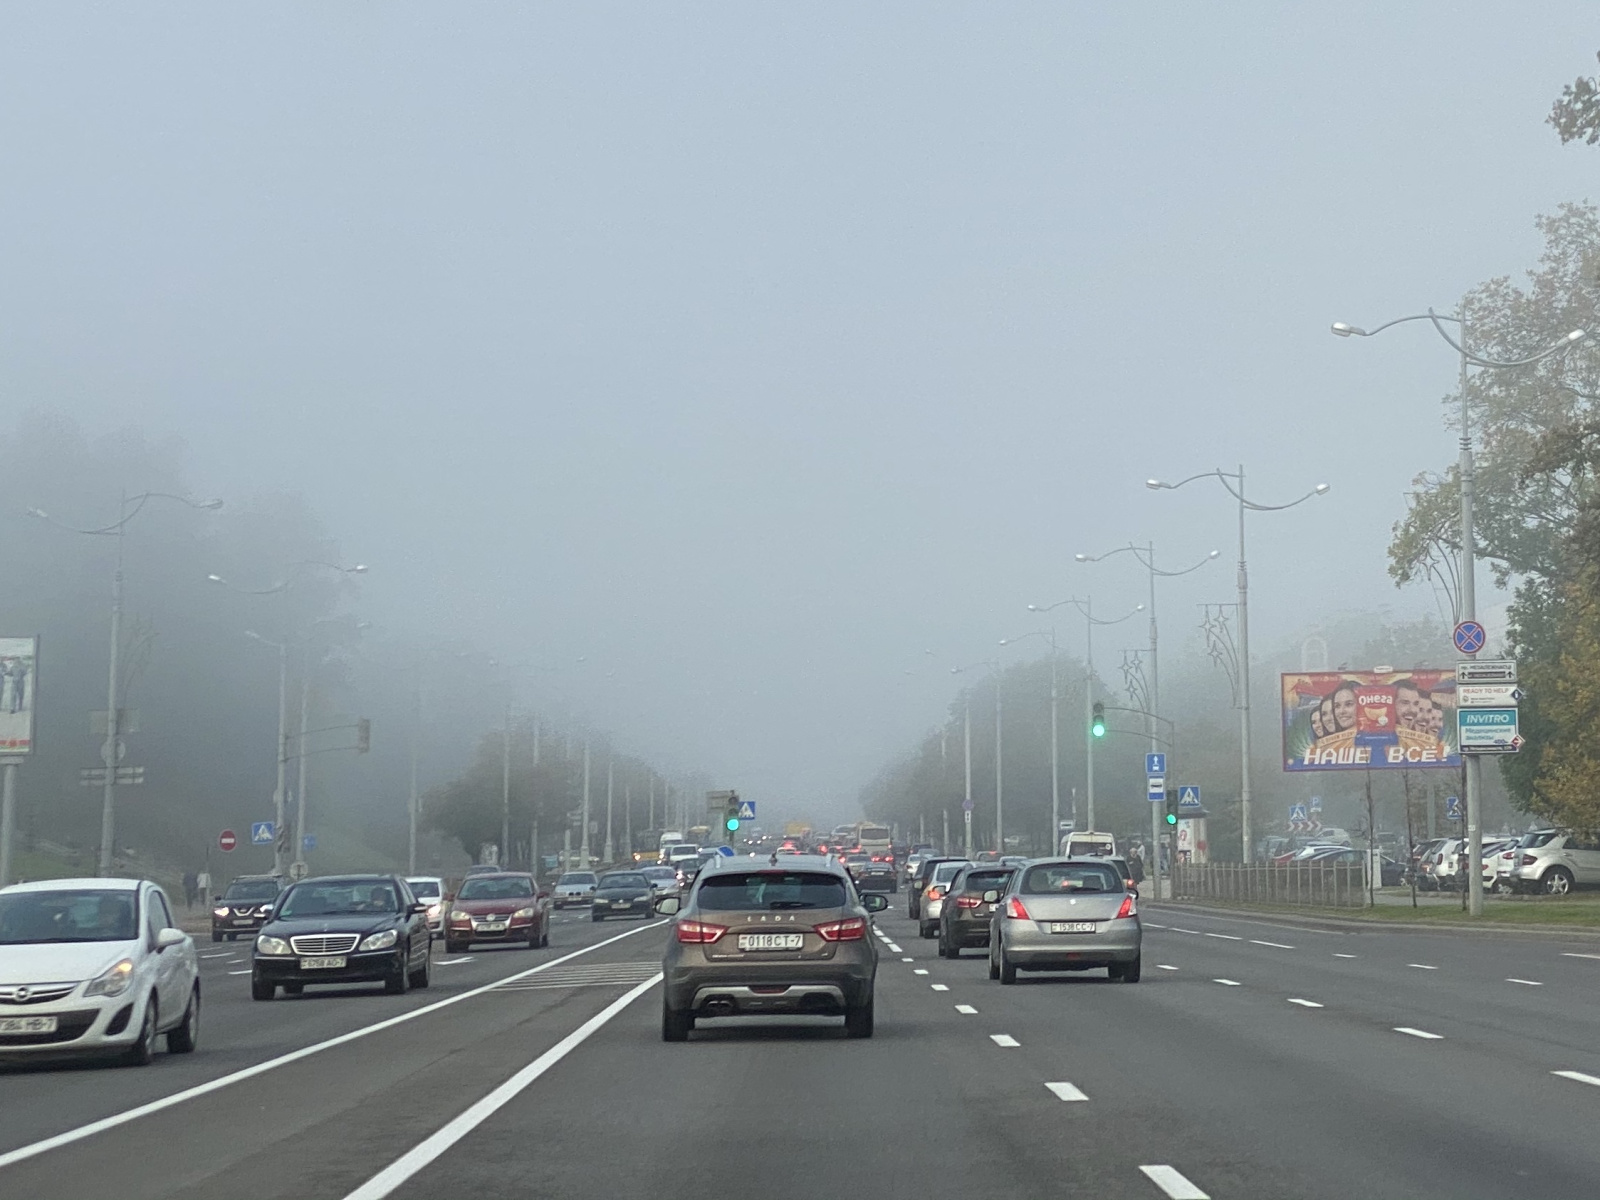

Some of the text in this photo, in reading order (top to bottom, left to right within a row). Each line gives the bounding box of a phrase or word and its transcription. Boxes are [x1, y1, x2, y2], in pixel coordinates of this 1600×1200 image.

[1466, 714, 1510, 723] INVITRO
[1303, 745, 1450, 765] НАШЕ ВСЁ!
